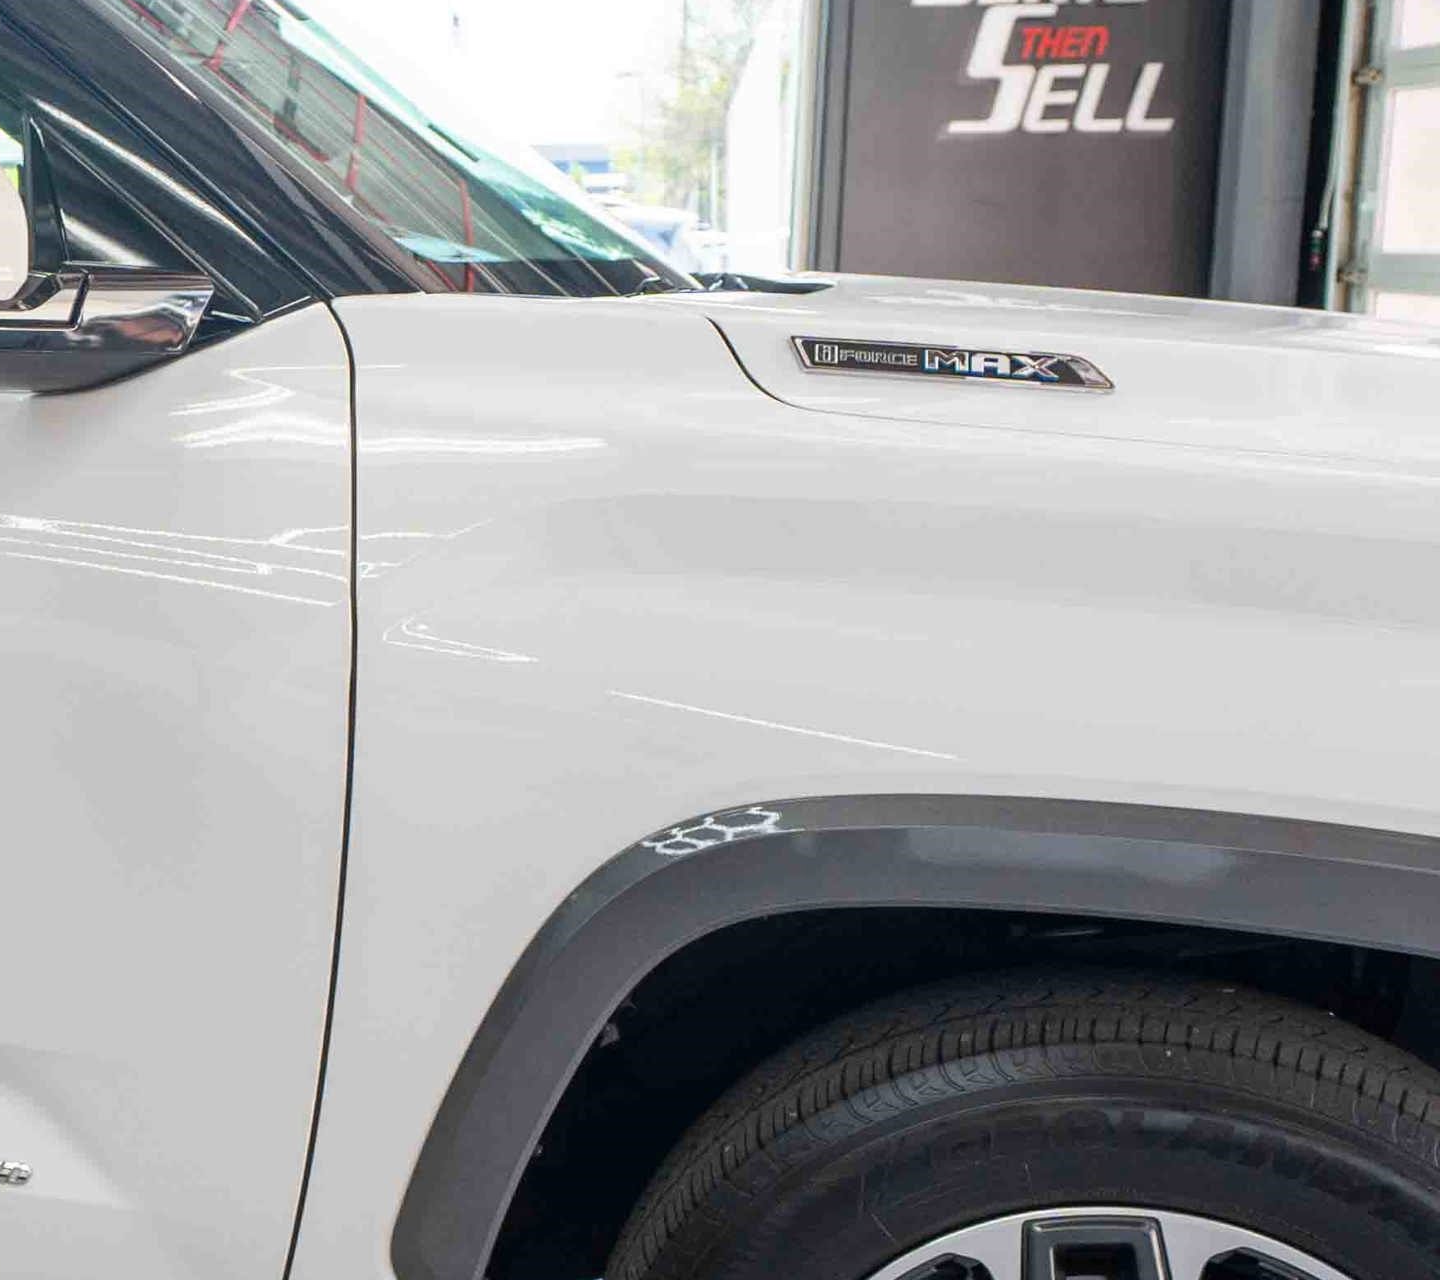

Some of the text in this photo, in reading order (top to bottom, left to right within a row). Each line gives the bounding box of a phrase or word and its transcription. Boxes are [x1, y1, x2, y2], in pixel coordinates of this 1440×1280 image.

[1021, 25, 1110, 59] THEN
[948, 4, 1175, 134] SELL
[923, 348, 1060, 382] MAX
